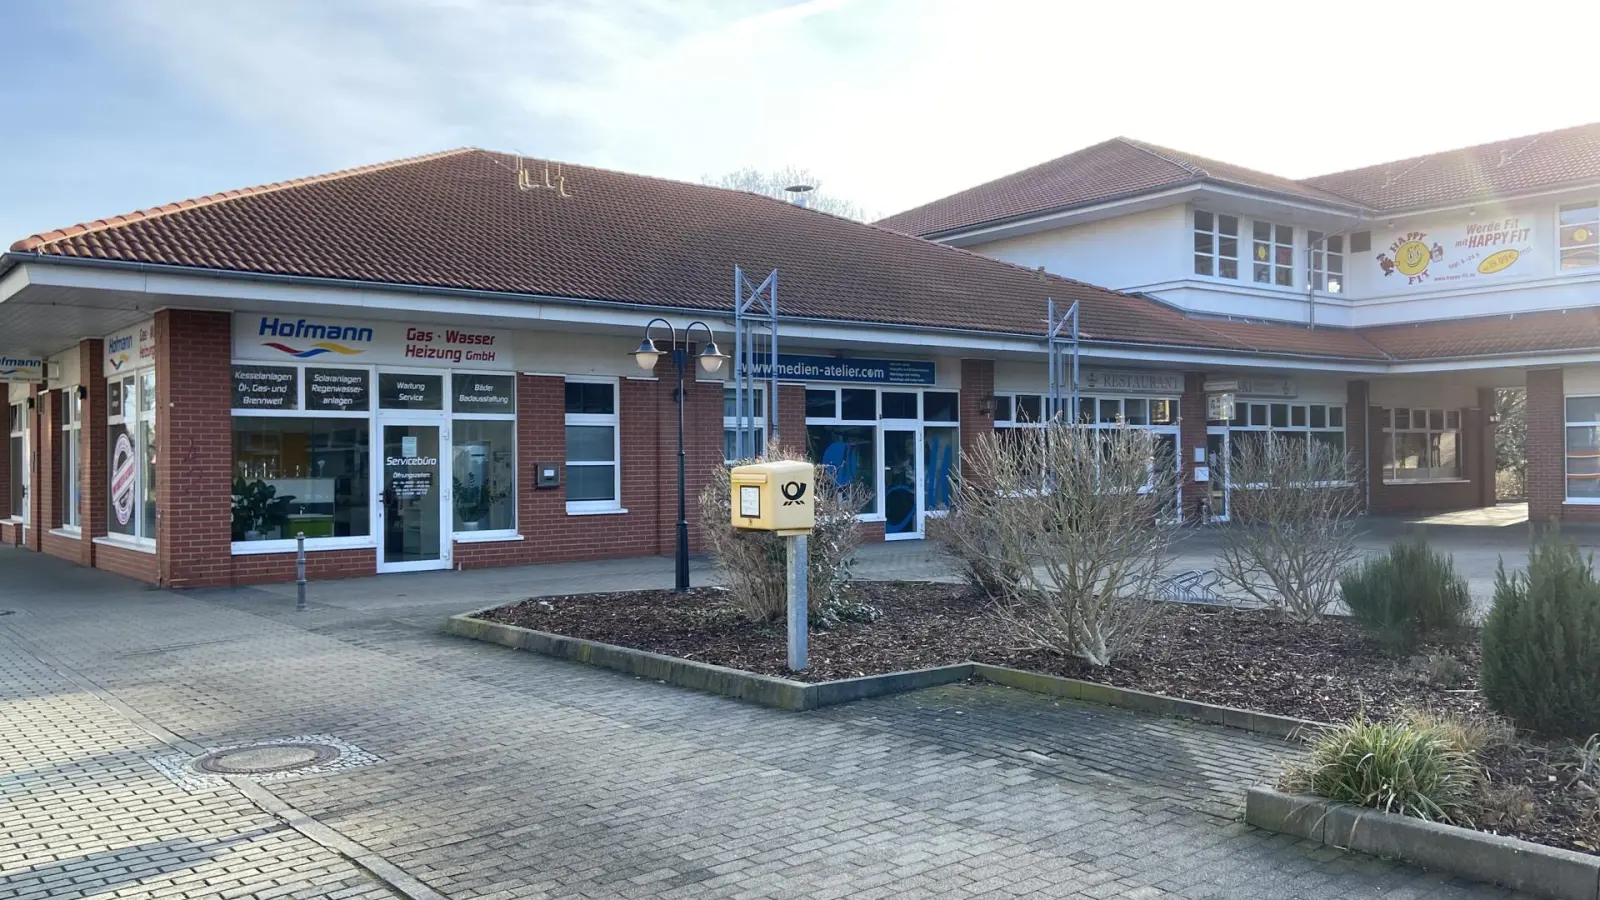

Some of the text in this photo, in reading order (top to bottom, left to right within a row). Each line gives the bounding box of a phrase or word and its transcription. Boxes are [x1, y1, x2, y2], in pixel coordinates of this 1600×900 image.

[1466, 218, 1519, 235] Werde Fit
[1389, 231, 1428, 252] HAPPY
[1455, 228, 1531, 249] mit HAPPY FIT
[1408, 269, 1430, 286] FIT
[259, 317, 373, 342] Hofmann
[406, 328, 495, 346] Gas Wasser
[405, 345, 496, 363] Heizung GmbH
[0, 356, 41, 368] fmann
[235, 371, 293, 382] Kesselanlagen
[313, 374, 362, 384] Solaranlagen
[1104, 373, 1179, 390] RESTAURANT
[252, 384, 270, 393] Gas-
[271, 385, 288, 393] und
[311, 384, 364, 395] Regenwasser-
[396, 382, 426, 392] Wartung
[474, 384, 494, 392] Bäder
[243, 396, 283, 405] Brennwert
[322, 396, 353, 406] anlagen
[398, 393, 424, 402] Service
[459, 395, 509, 404] Badausstattung
[386, 456, 437, 466] Servicebüro
